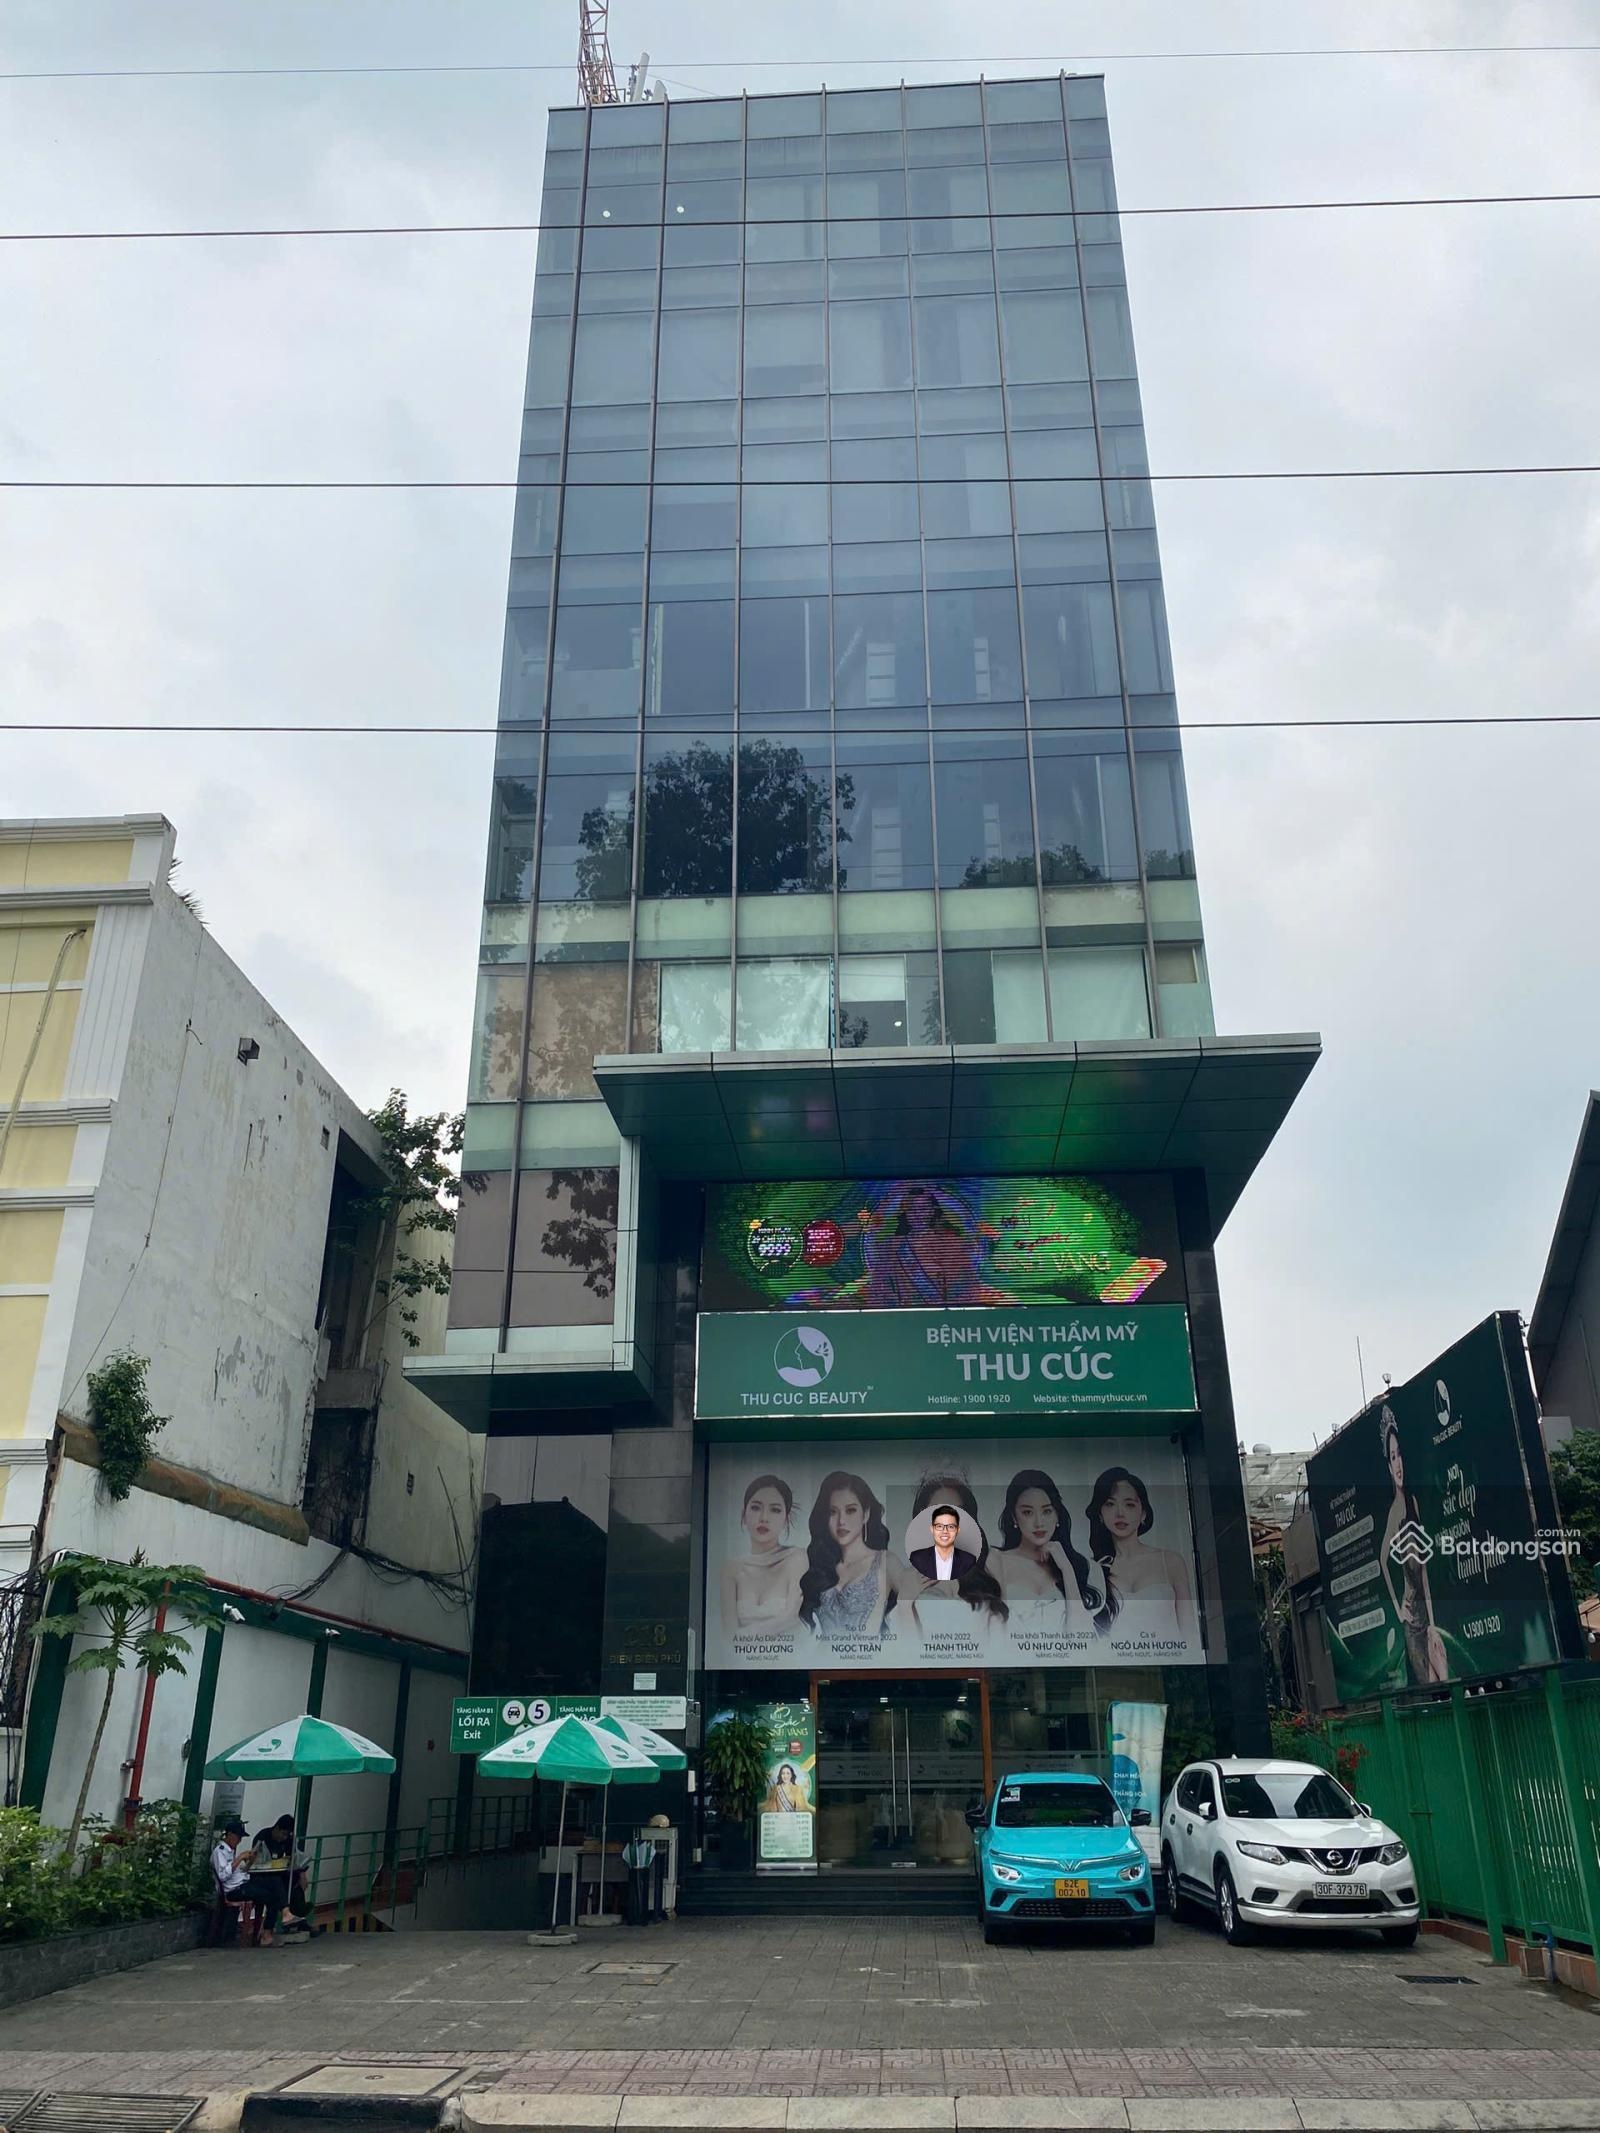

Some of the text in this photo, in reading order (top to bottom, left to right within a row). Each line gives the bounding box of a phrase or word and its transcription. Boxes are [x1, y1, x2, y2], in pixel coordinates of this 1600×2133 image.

[926, 1320, 1138, 1347] BỆNH VIỆN THẨM MỸ
[956, 1345, 1114, 1381] THU CÚC
[740, 1393, 769, 1405] THU
[772, 1393, 804, 1405] CUC
[809, 1391, 868, 1405] BEAUTY
[927, 1394, 1011, 1404] Hotline: 1900 1920
[1033, 1393, 1148, 1406] Website: thammythucuc.vn
[858, 1624, 866, 1632] 10
[777, 1634, 795, 1642] 2023
[816, 1634, 830, 1642] Miss
[832, 1634, 851, 1642] Grand
[880, 1633, 897, 1641] 2023
[954, 1633, 971, 1641] 2022
[1040, 1632, 1061, 1640] Thanh
[1076, 1632, 1094, 1640] 2023
[759, 1643, 794, 1653] DƯƠNG
[831, 1643, 857, 1653] NGỌC
[923, 1643, 954, 1651] THANH
[1033, 1642, 1053, 1651] NHƯ
[1111, 1640, 1187, 1650] NGÔ LAN HƯƠNG
[534, 1703, 544, 1720] 5
[458, 1714, 490, 1727] LỐI RA
[463, 1730, 482, 1740] Exit
